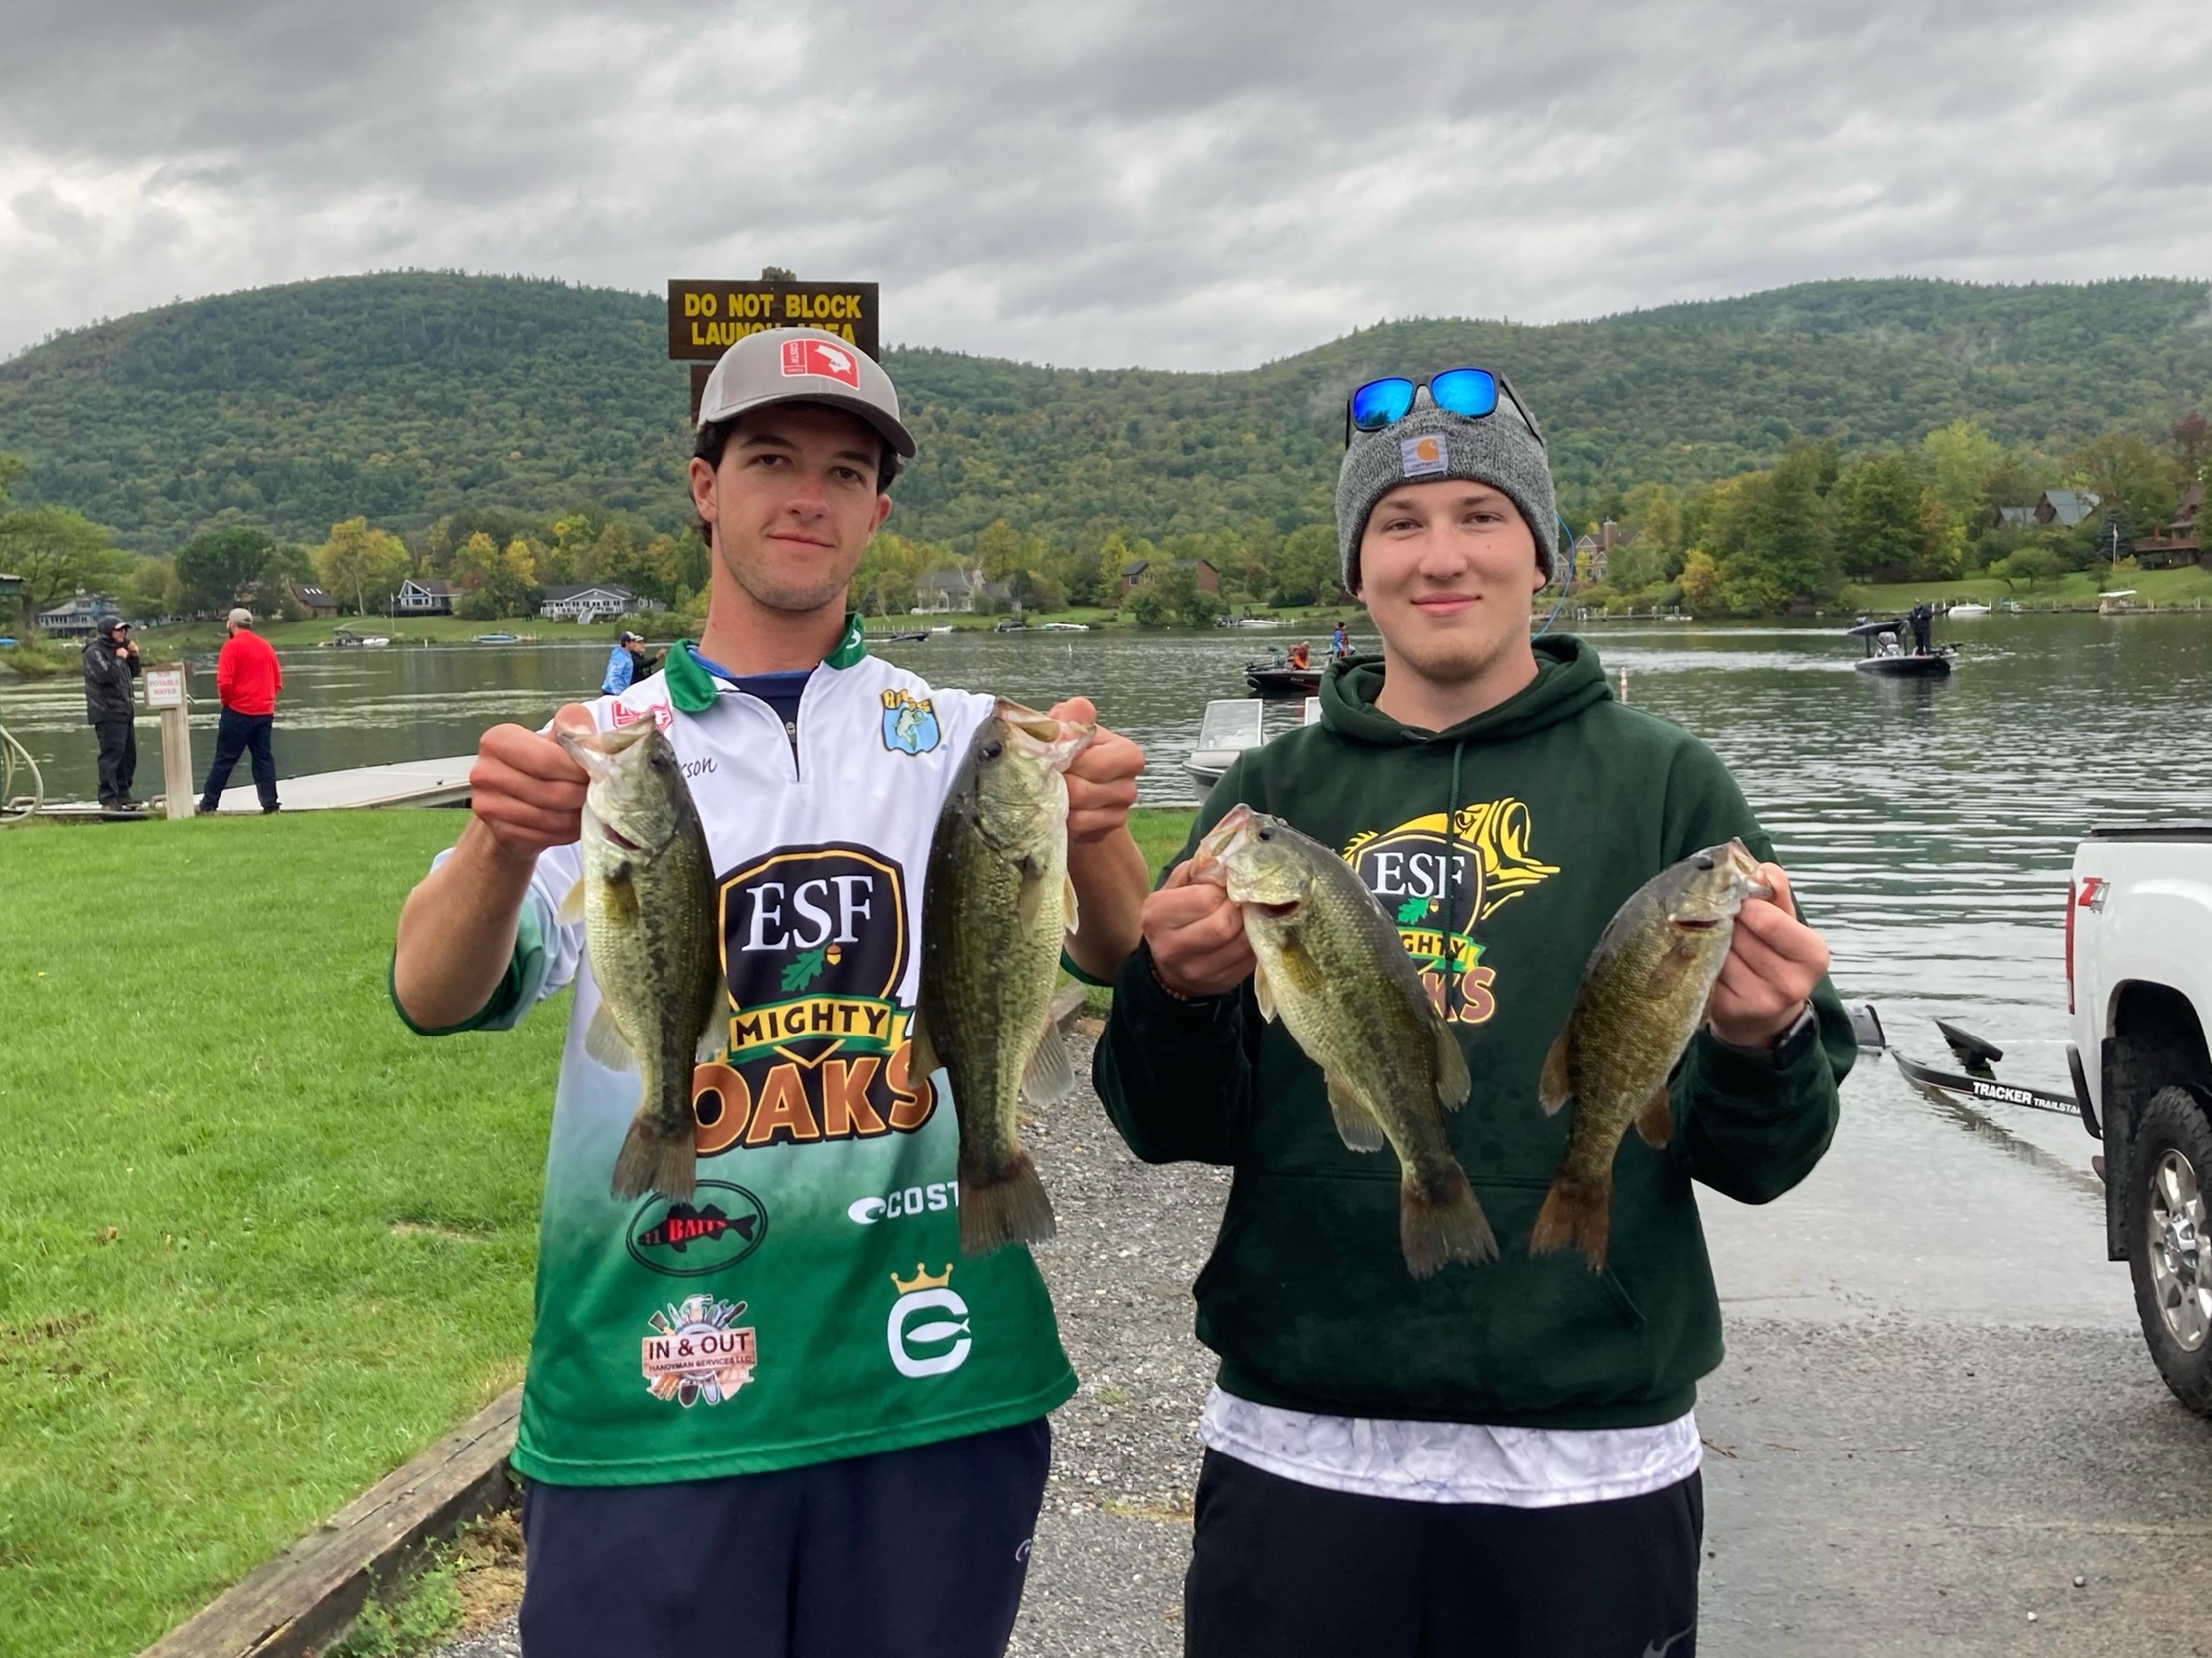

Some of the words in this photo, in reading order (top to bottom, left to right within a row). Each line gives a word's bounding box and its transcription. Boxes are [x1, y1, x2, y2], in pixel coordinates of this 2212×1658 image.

[684, 294, 717, 317] DO
[729, 294, 773, 318] NOT
[785, 295, 862, 318] BLOCK
[1371, 852, 1465, 899] ESF
[742, 876, 873, 951] ESF
[1401, 933, 1467, 959] GHTY
[736, 1003, 888, 1046] MIGHTY
[692, 1039, 932, 1153] OAKS
[1973, 1081, 2033, 1105] TRACKER
[887, 1181, 959, 1219] COST
[669, 1218, 727, 1242] BAITS
[649, 1340, 670, 1360] IN
[678, 1338, 695, 1357] &
[701, 1333, 750, 1354] OUT
[649, 1360, 694, 1372] HANDYMAN
[696, 1356, 735, 1367] SERVICES
